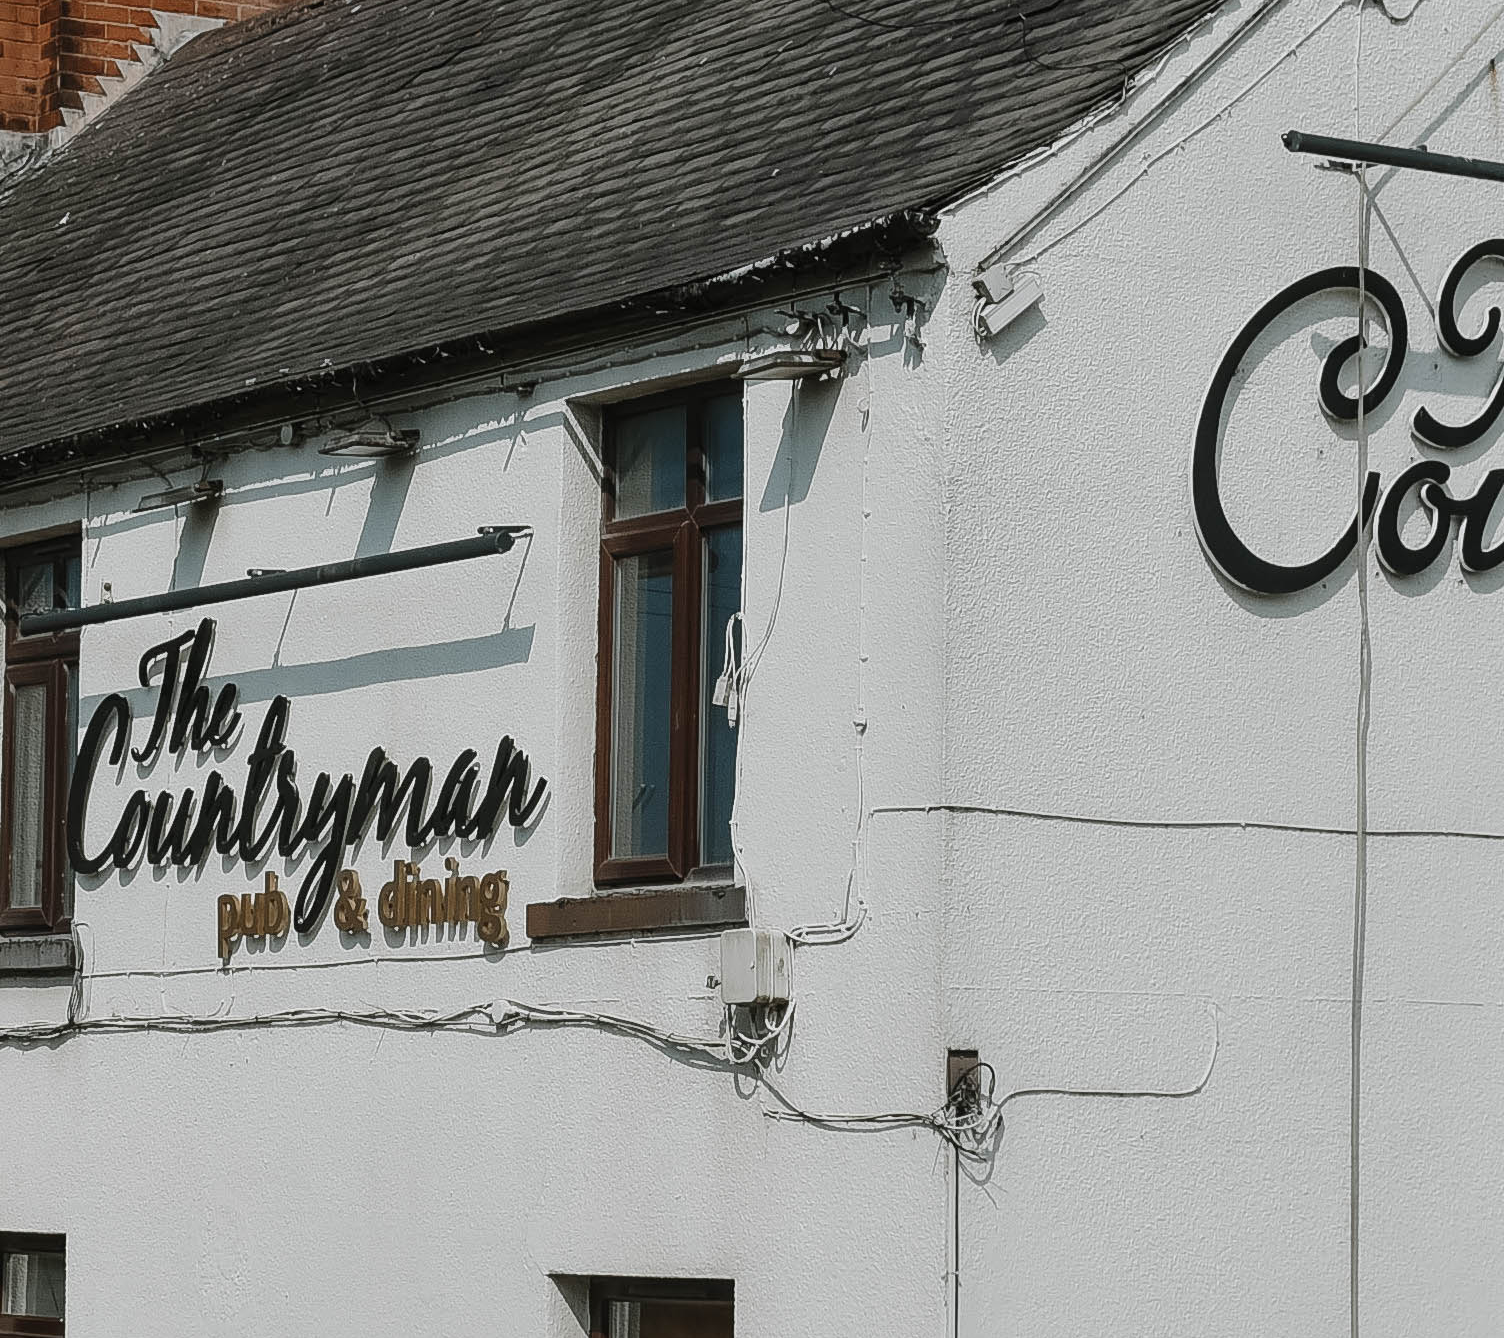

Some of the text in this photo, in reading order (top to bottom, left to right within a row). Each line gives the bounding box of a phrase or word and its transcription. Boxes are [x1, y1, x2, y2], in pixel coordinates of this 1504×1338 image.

[131, 618, 242, 764] The
[66, 695, 549, 934] Countryman
[218, 857, 509, 958] pub & dining
